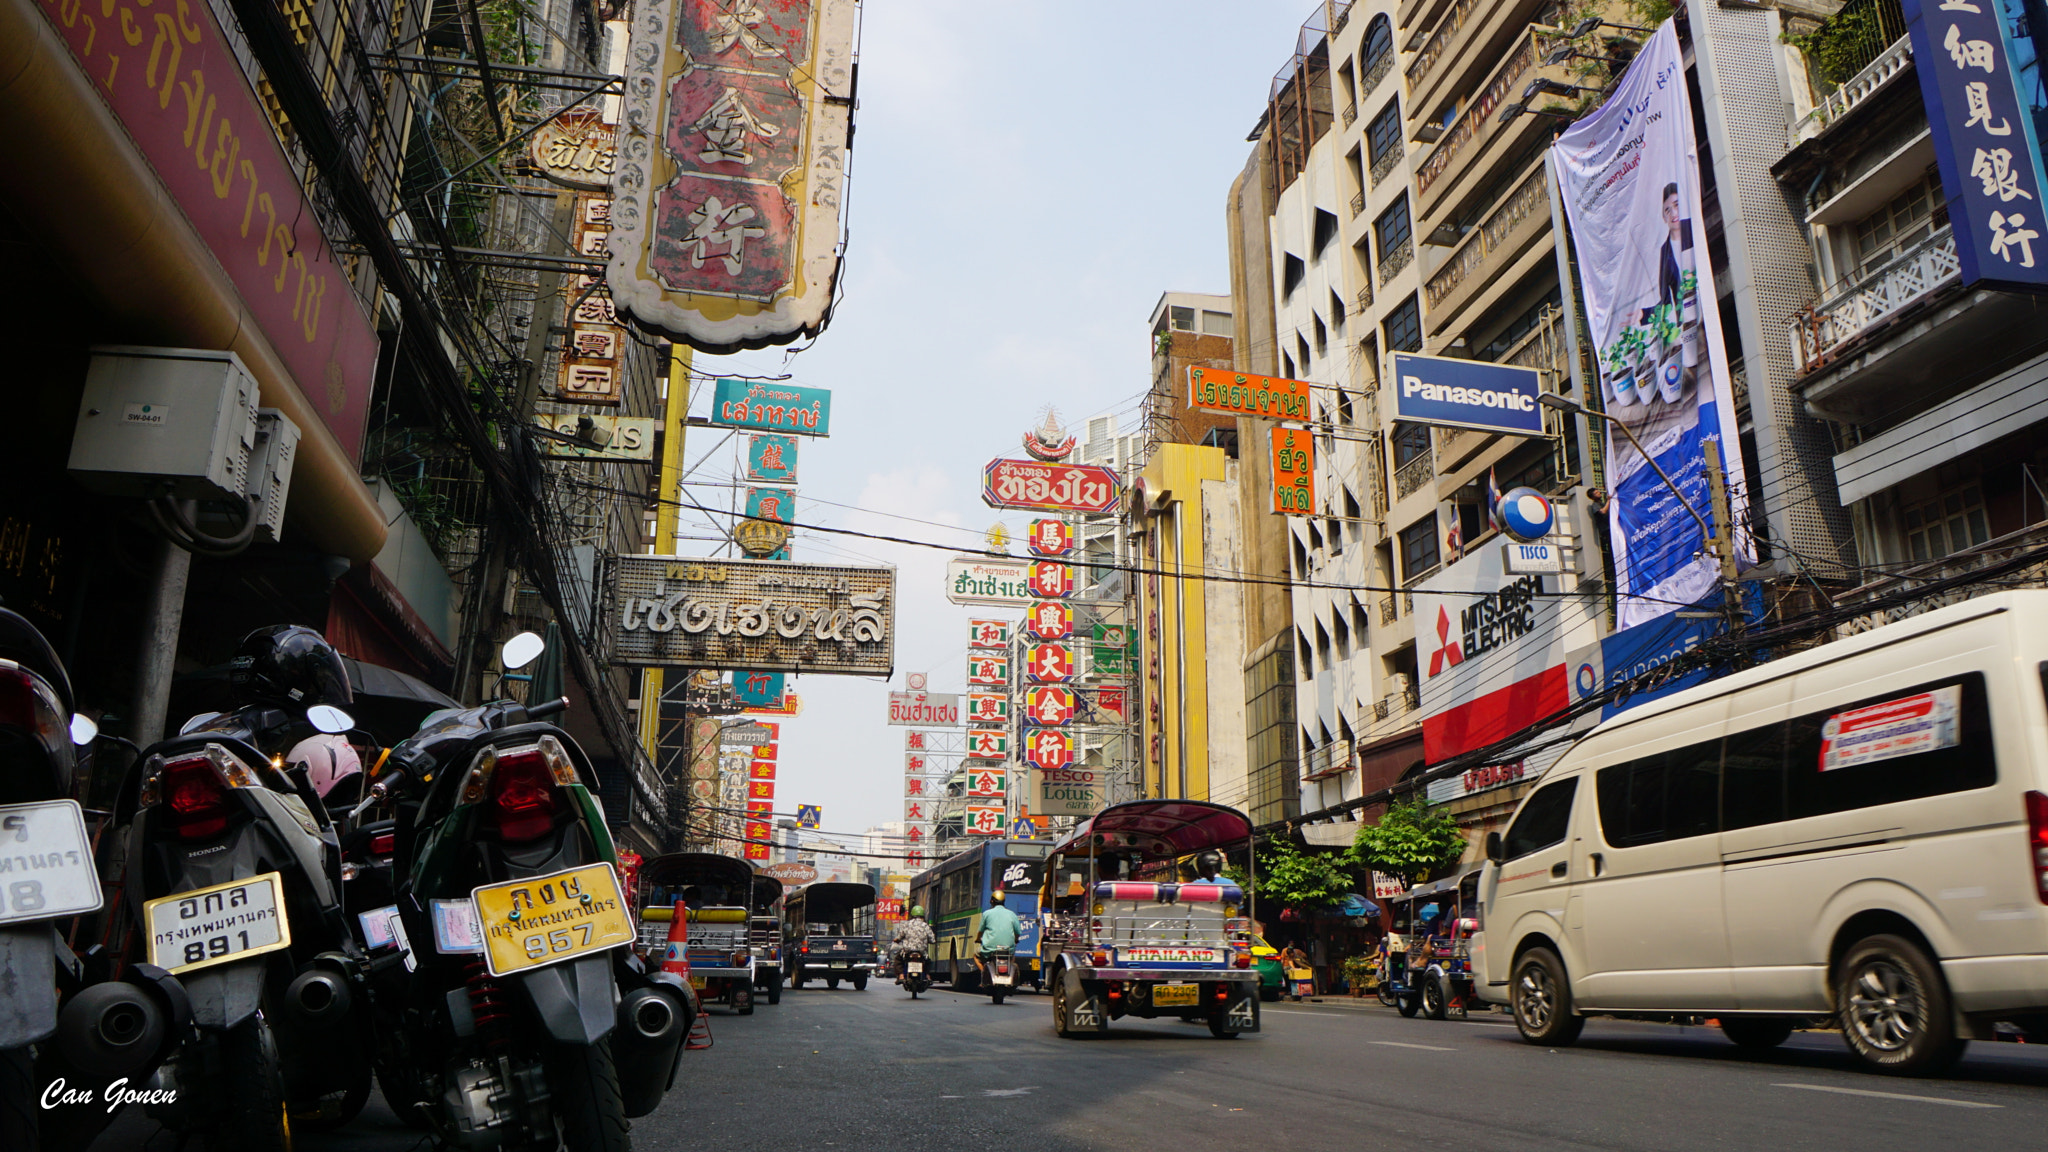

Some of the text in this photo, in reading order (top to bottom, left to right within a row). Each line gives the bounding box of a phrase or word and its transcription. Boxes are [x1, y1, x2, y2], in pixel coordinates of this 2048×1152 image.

[1939, 0, 2039, 267] 細見銀行
[748, 386, 801, 402] ห้างทอง
[1193, 369, 1309, 418] โรงรับจำนำ
[1402, 375, 1535, 412] Panasonic
[127, 413, 162, 423] SW-04-01
[722, 397, 821, 429] เล่งหงษ์
[1278, 429, 1309, 473] ฮั่ว
[997, 470, 1108, 506] ทองใบ
[999, 463, 1052, 478] ห้างทอง
[1278, 476, 1311, 511] หลี
[1519, 545, 1549, 560] TISCO
[666, 563, 727, 583] ทอง
[622, 582, 886, 643] เซ่งเฮงหลี
[1037, 522, 1066, 766] 馬利興大金行
[1462, 604, 1535, 662] ELECTRIC
[974, 625, 1001, 832] 和成興大金行
[1041, 770, 1094, 783] TESCO
[1043, 786, 1094, 801] Lotus
[187, 845, 227, 858] HONDA
[179, 886, 249, 920] อกล
[490, 896, 616, 938] กรุงเทพมหานคร
[878, 901, 891, 913] 24
[155, 906, 277, 945] กรุงเทพมหานคร
[523, 922, 595, 960] 957
[183, 929, 251, 965] 891
[1127, 949, 1214, 962] THAILAND
